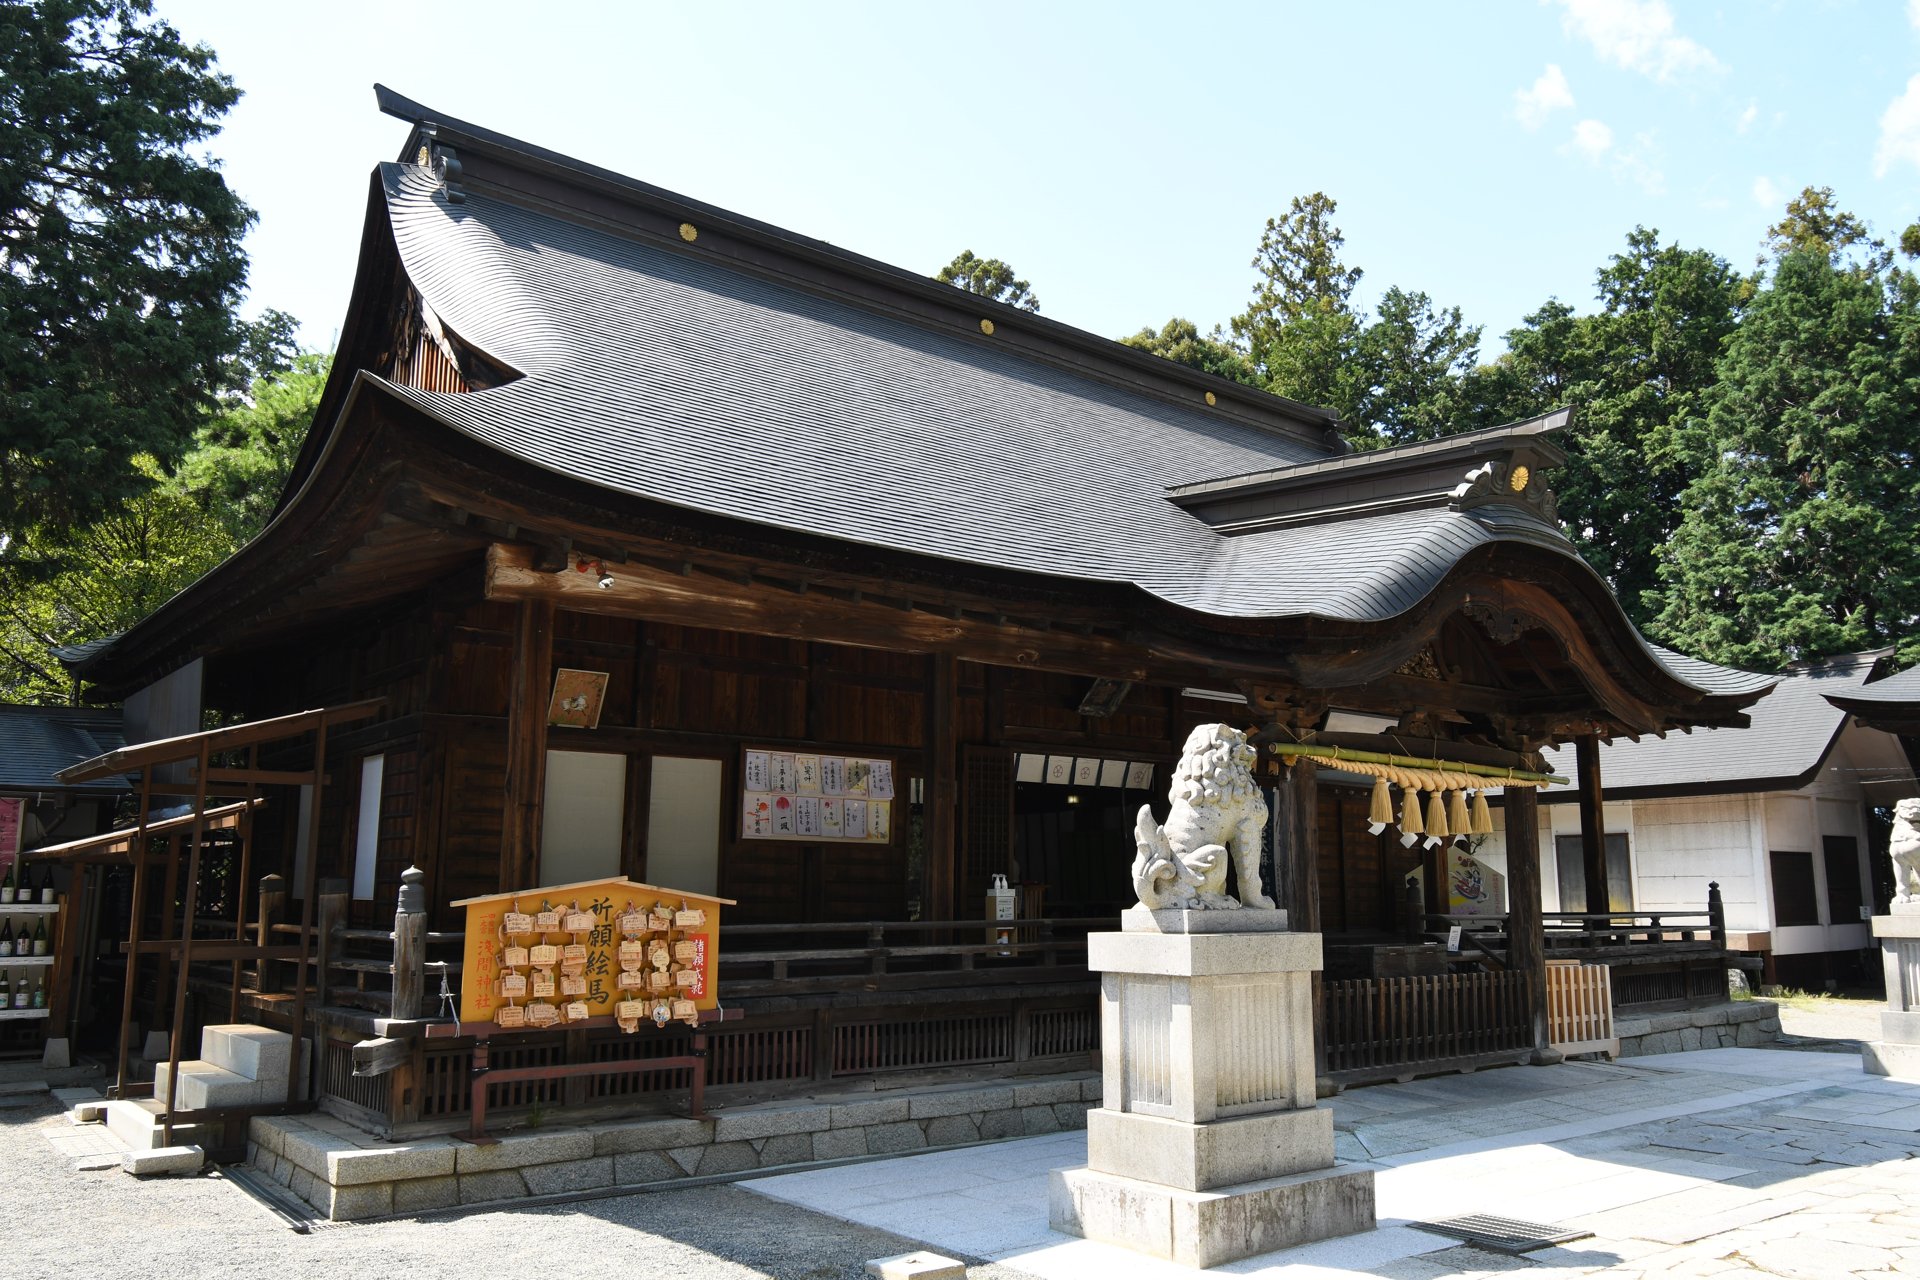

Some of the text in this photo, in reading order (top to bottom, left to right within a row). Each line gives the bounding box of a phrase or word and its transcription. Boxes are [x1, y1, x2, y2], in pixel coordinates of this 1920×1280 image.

[584, 897, 613, 1004] 祈願絵馬
[691, 939, 705, 995] 諸願成就
